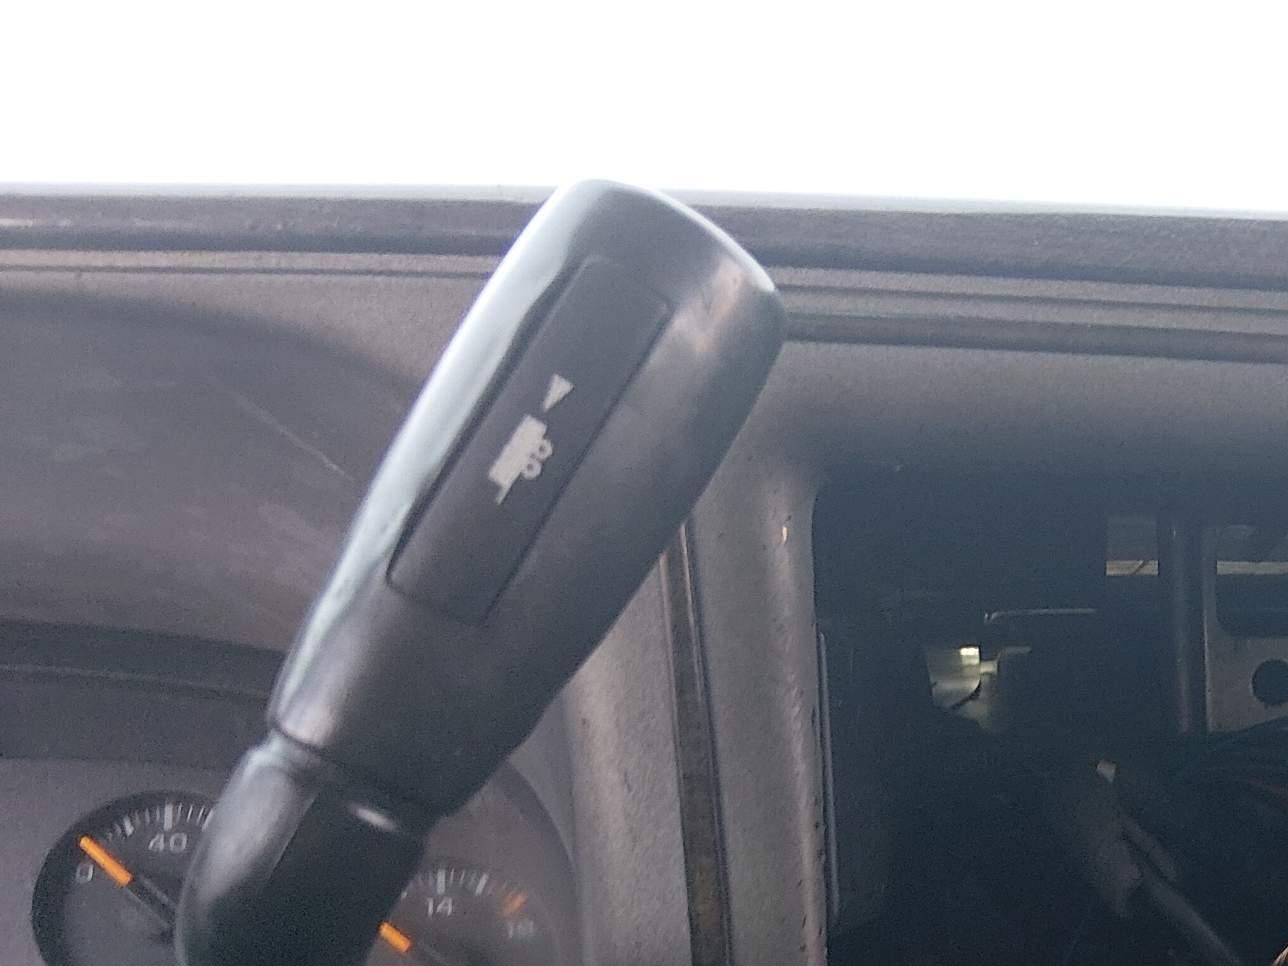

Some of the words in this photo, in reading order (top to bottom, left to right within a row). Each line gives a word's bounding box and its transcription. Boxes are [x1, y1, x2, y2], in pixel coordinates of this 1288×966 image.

[148, 832, 188, 852] 40
[75, 861, 95, 884] 0
[427, 898, 453, 917] 14
